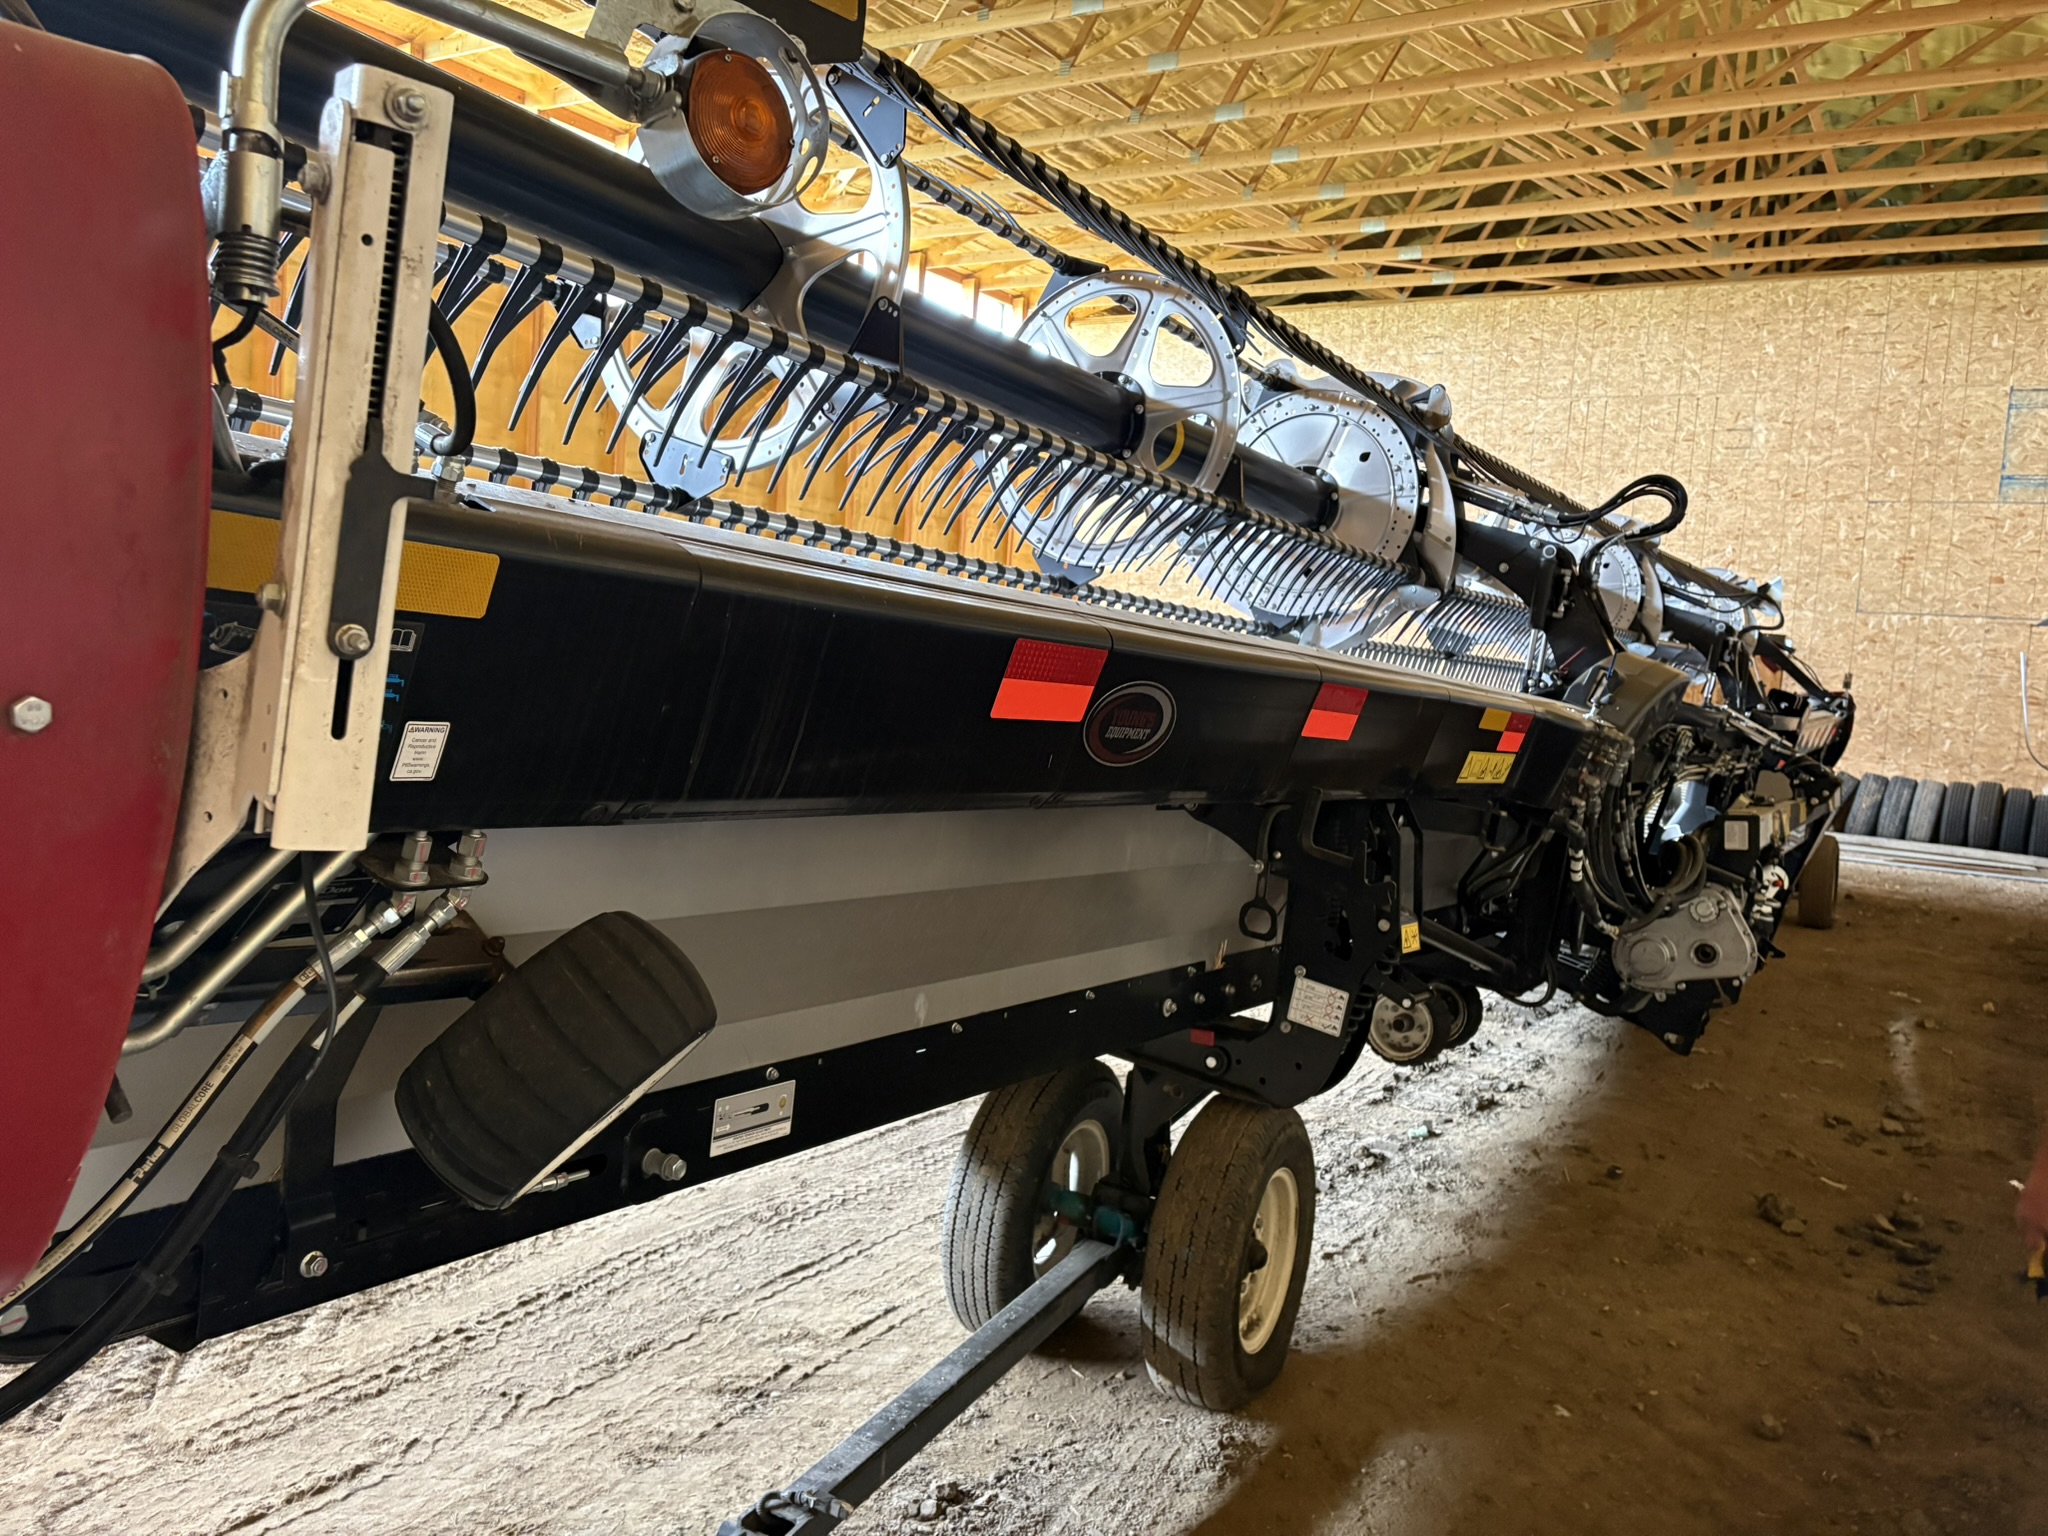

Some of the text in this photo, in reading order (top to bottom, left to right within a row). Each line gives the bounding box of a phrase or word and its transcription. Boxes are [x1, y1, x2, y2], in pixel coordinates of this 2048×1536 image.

[1104, 725, 1151, 739] EQUIPMENT
[171, 1080, 214, 1133] GLOBALCORE
[132, 1145, 165, 1179] Parker
